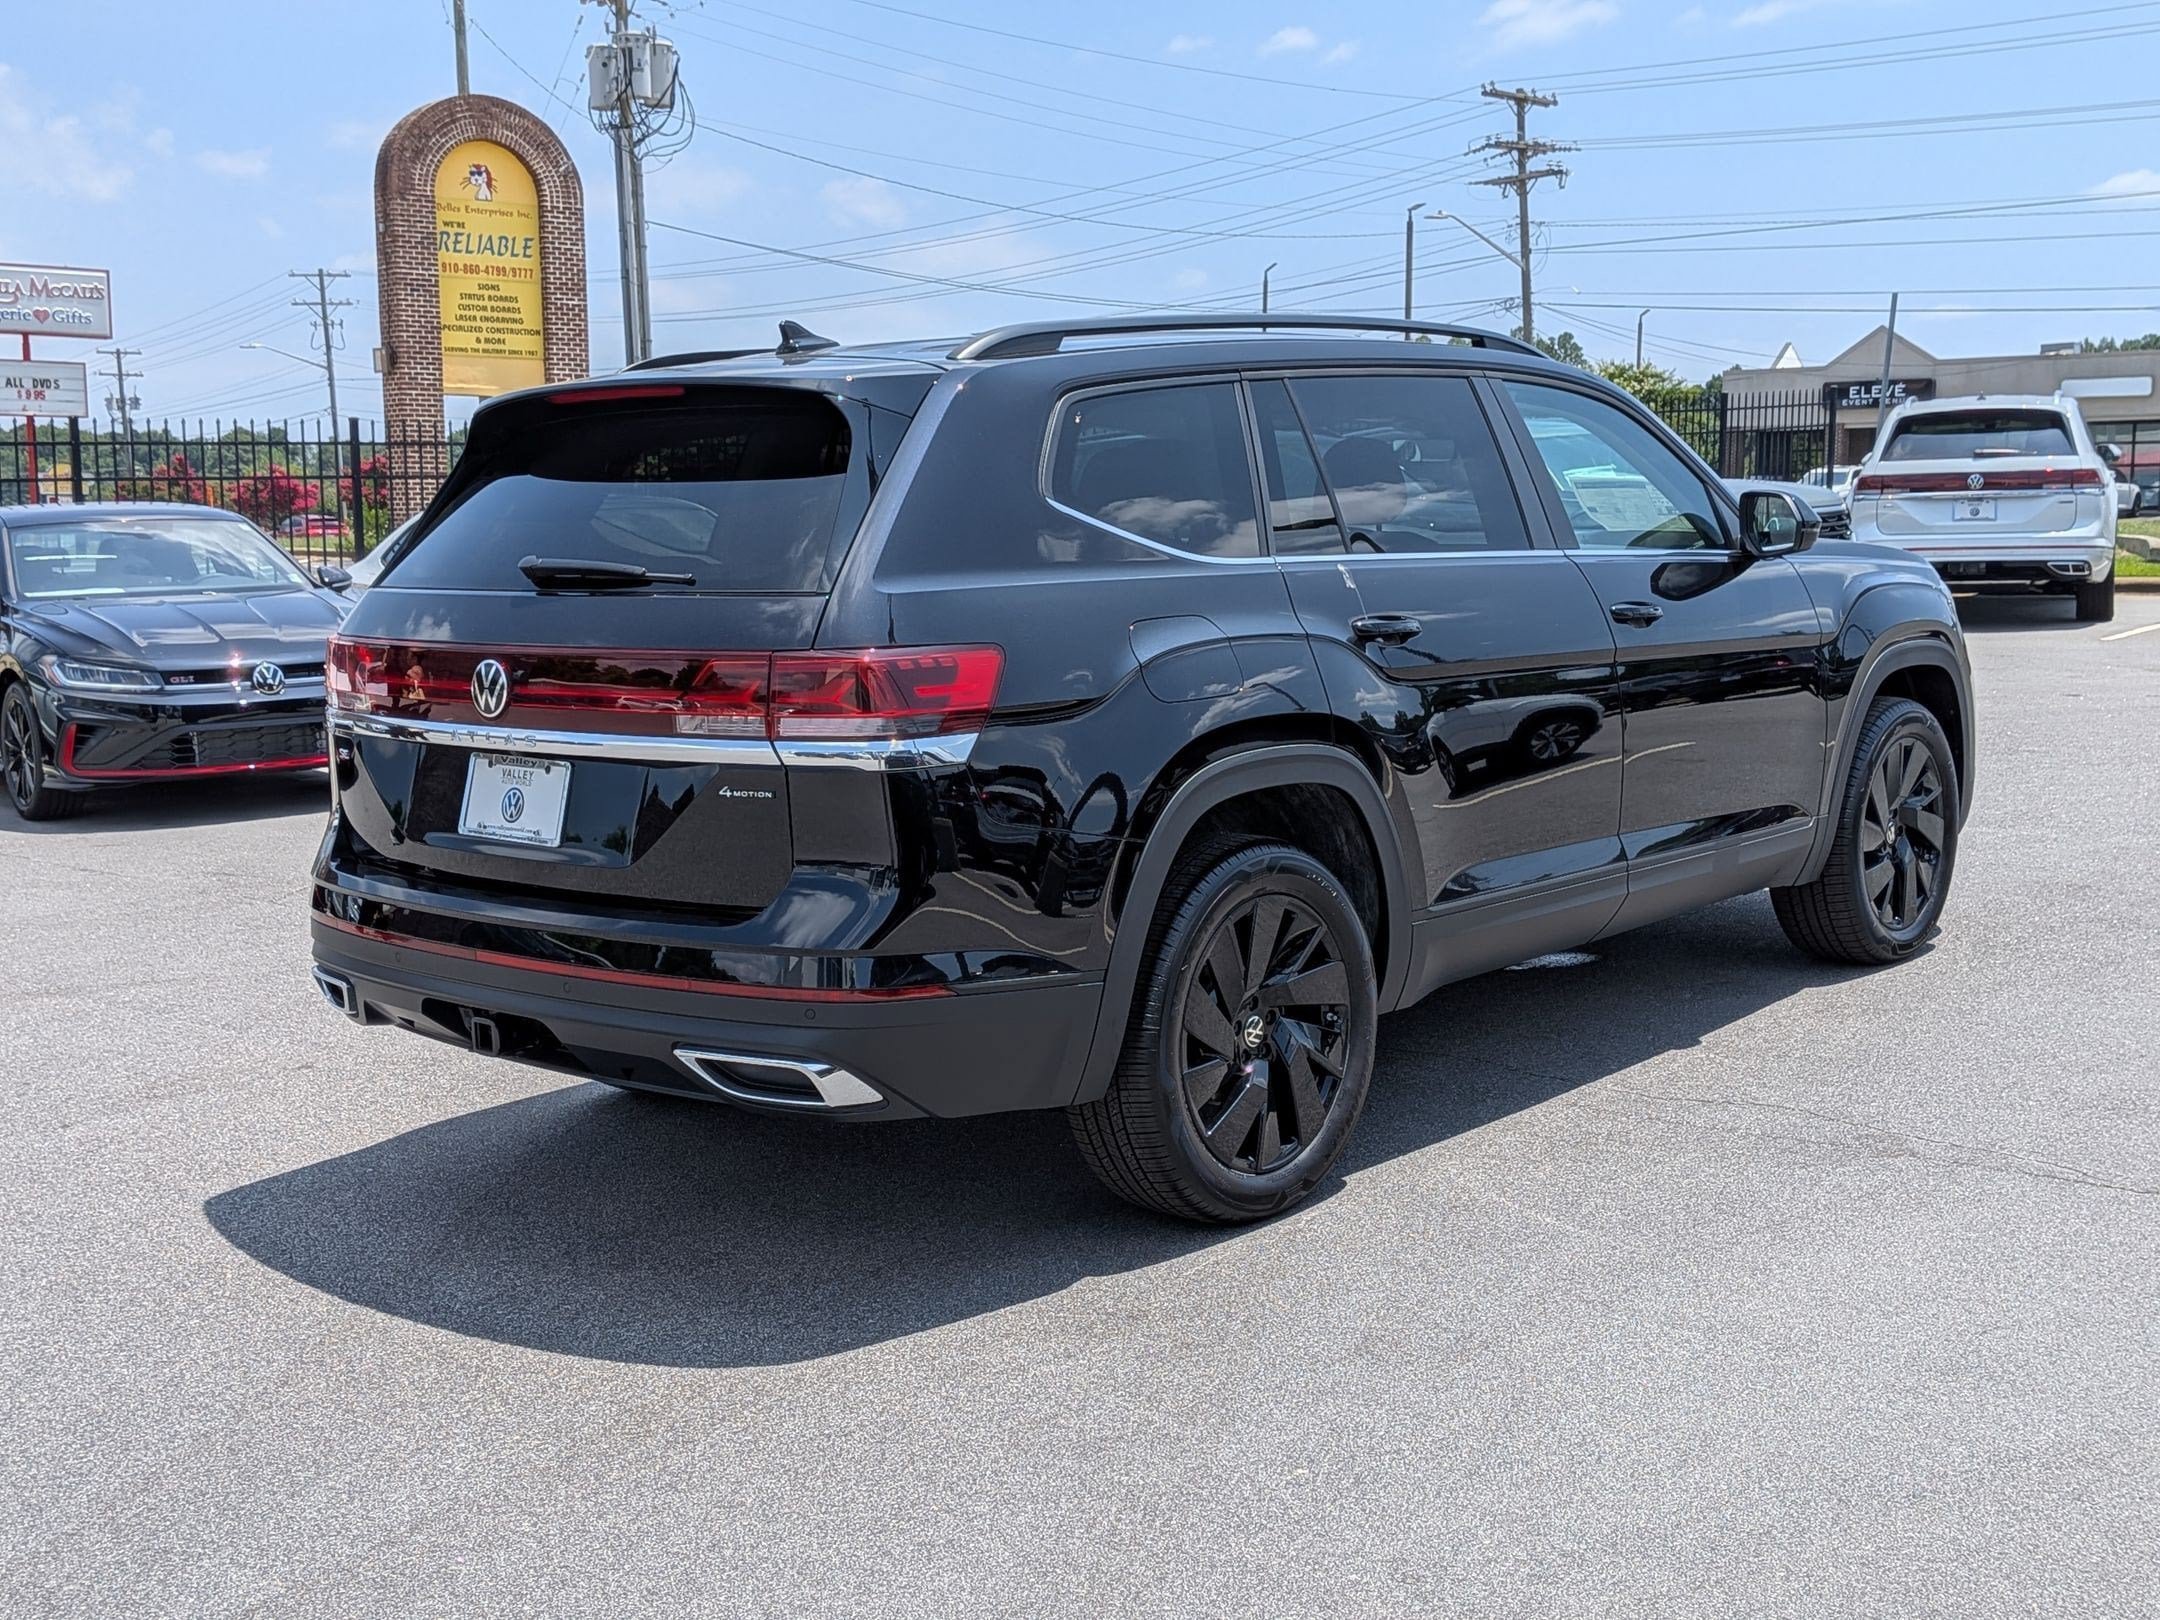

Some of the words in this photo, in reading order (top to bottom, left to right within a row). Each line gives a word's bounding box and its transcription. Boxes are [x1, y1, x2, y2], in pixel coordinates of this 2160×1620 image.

[464, 205, 514, 218] Enterprises
[441, 220, 466, 229] WE'RE
[438, 231, 535, 258] RELIABLE
[441, 262, 534, 280] 910-860-4799/9777
[477, 283, 501, 292] SIGNS
[459, 293, 485, 302] STATUS
[487, 294, 519, 303] BOARDS
[457, 304, 488, 313] CUSTOM
[490, 305, 522, 315] BOARDS
[0, 306, 32, 322] erie
[52, 307, 93, 325] Gifts
[455, 314, 478, 323] LASER
[480, 315, 525, 325] ENGRAVING
[442, 324, 484, 334] PECIALIZED
[485, 326, 541, 336] CONSTRUCTION
[484, 337, 507, 346] MORE
[443, 346, 469, 354] SERVING
[5, 377, 24, 388] ALL
[1841, 398, 1874, 407] EVENT
[451, 729, 537, 748] ATLAS
[501, 756, 538, 768] Valley
[501, 768, 535, 780] VALLEY
[718, 785, 773, 798] 4MOTION
